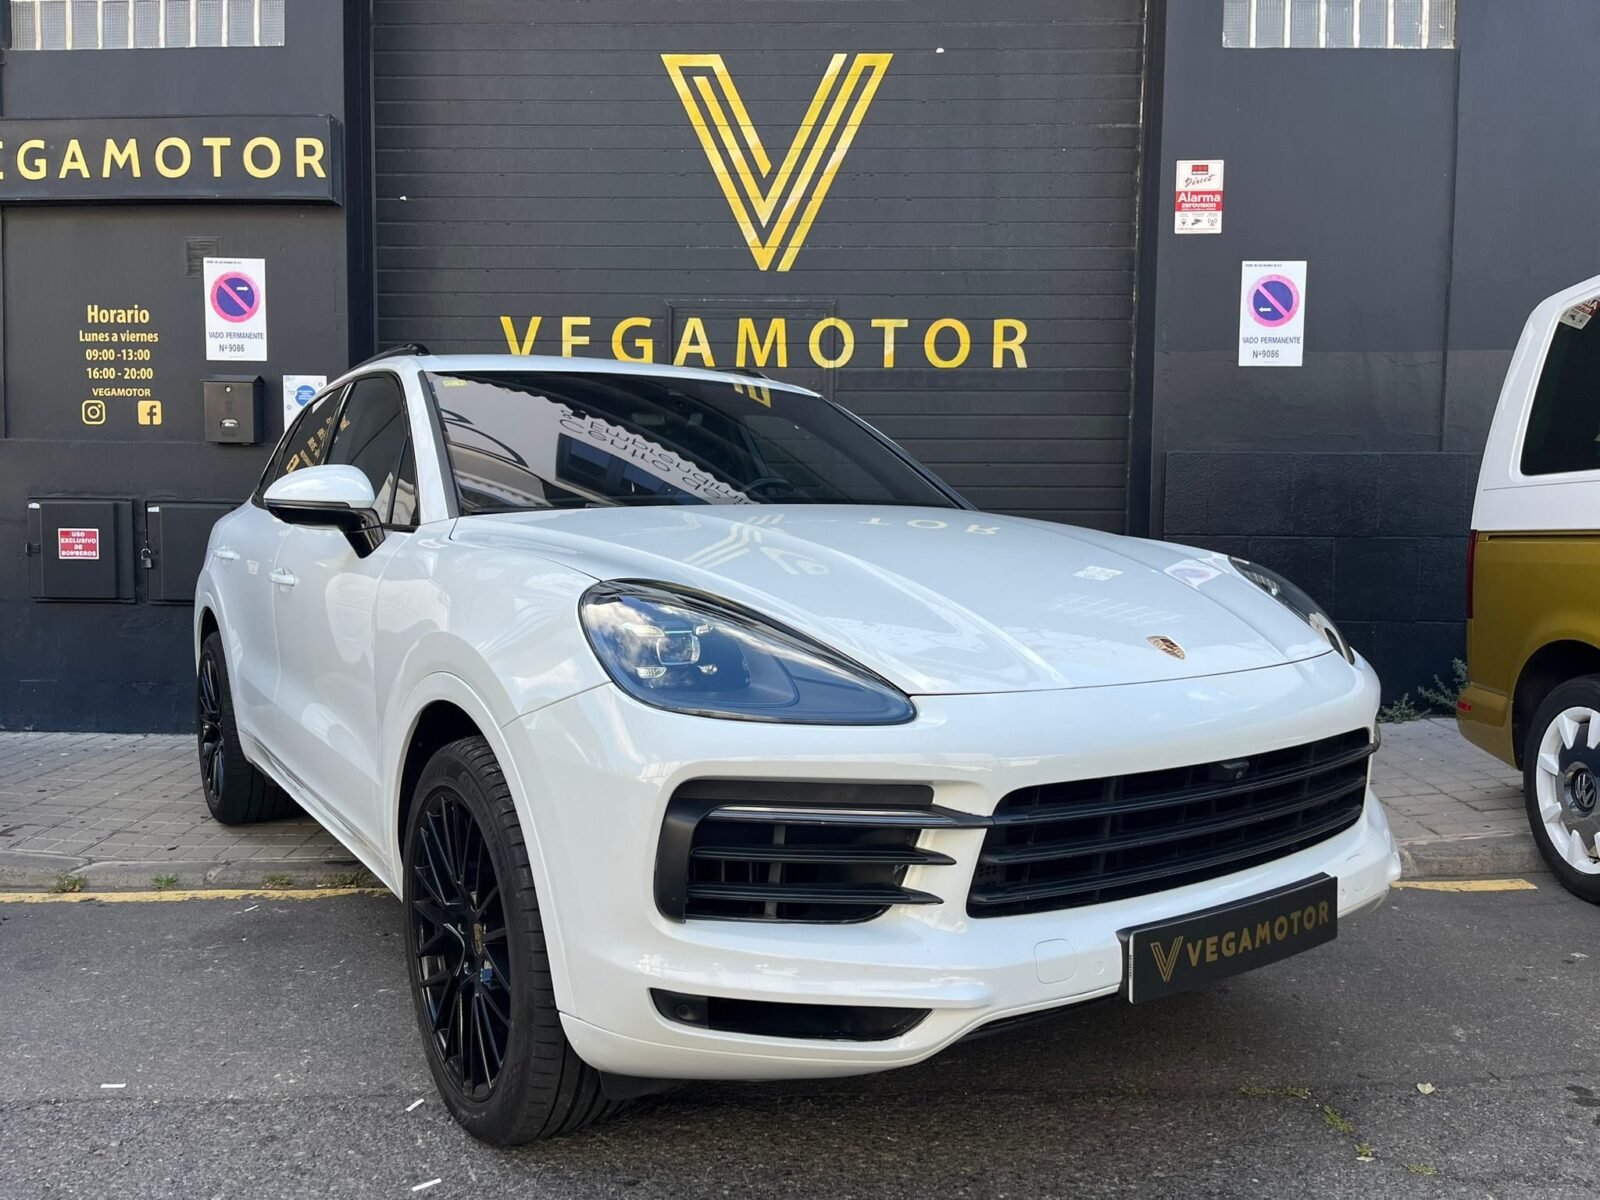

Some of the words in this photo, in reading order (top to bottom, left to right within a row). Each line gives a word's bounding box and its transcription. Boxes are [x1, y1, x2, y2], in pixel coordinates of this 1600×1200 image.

[0, 136, 327, 181] GAMOTOR
[1178, 191, 1221, 203] Alarma
[87, 304, 150, 324] Horario
[79, 330, 109, 342] Lunes
[111, 332, 118, 342] a
[120, 330, 159, 342] viernes
[208, 331, 224, 339] VADO
[226, 331, 264, 340] PERMANENTE
[1242, 336, 1259, 344] VADO
[1261, 336, 1301, 345] PERMANENTE
[85, 349, 115, 361] 09:00
[86, 367, 116, 380] 16:00
[123, 367, 154, 380] 20:00
[92, 388, 151, 397] VEGAMOTOR
[1186, 900, 1329, 967] VEGAMOTOR
